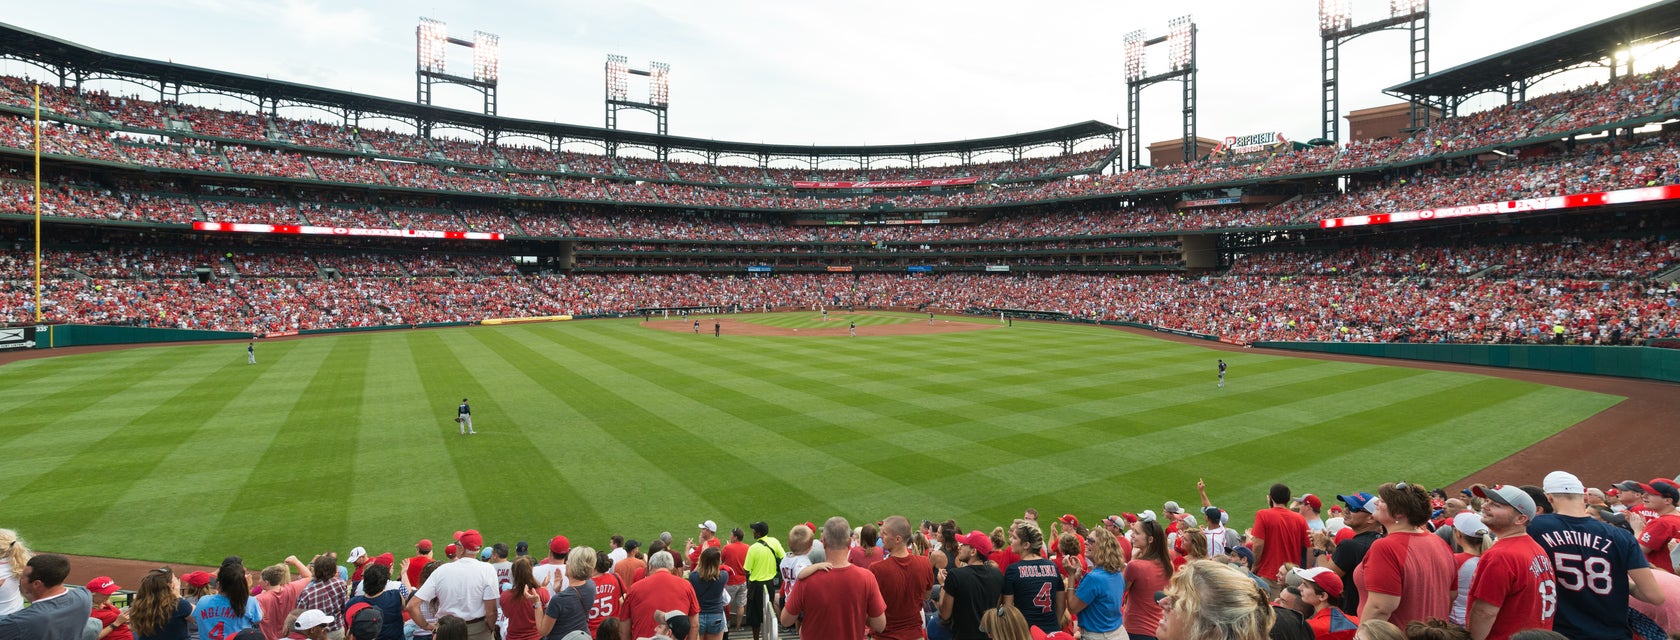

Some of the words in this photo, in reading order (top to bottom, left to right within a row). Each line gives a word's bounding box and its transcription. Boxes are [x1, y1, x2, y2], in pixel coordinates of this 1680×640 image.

[1225, 131, 1275, 150] PERFICIENT
[1541, 530, 1613, 554] MARTINEZ
[497, 568, 510, 577] CHA
[1018, 565, 1058, 578] MOLINA
[1554, 552, 1613, 595] 58
[595, 584, 615, 595] COTTY
[1033, 582, 1052, 614] 4
[208, 621, 225, 640] 4
